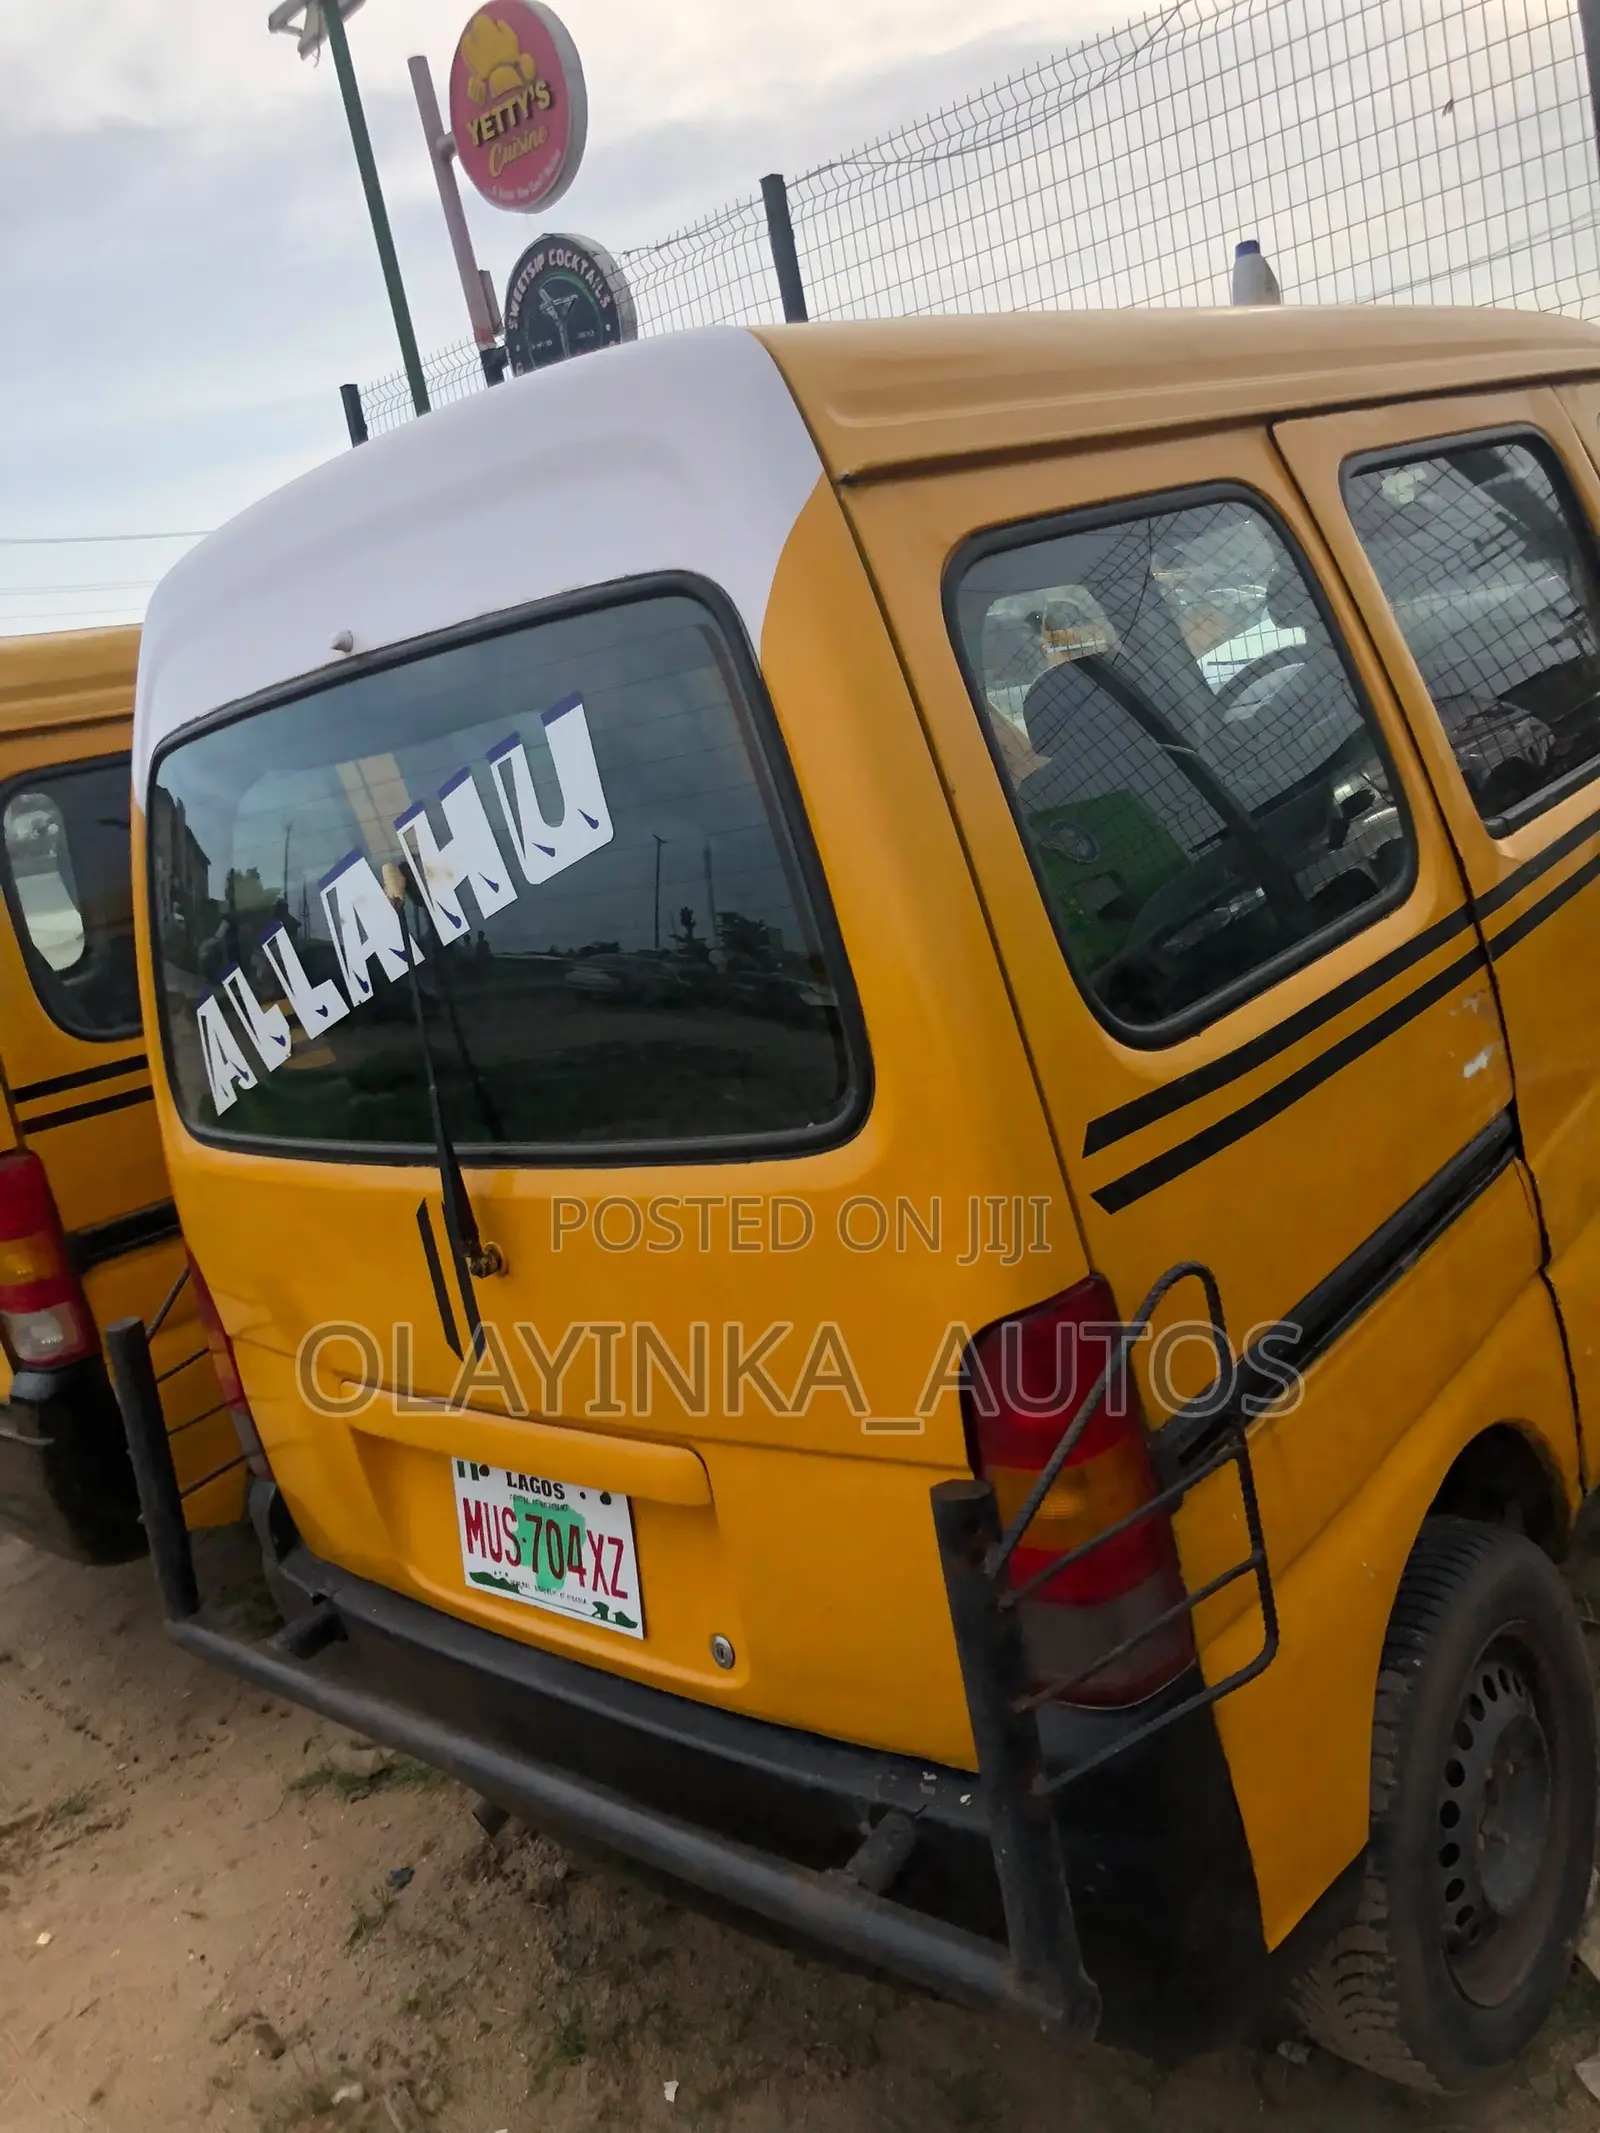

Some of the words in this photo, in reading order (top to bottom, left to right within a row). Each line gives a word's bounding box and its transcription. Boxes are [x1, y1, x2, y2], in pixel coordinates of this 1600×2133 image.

[467, 79, 554, 147] YETTY'S
[489, 124, 548, 178] Cuisine
[508, 252, 545, 330] SWEETSIP
[548, 247, 610, 309] COCKTAILS
[197, 691, 614, 1117] ALLAHU
[506, 1471, 566, 1500] LAGOS
